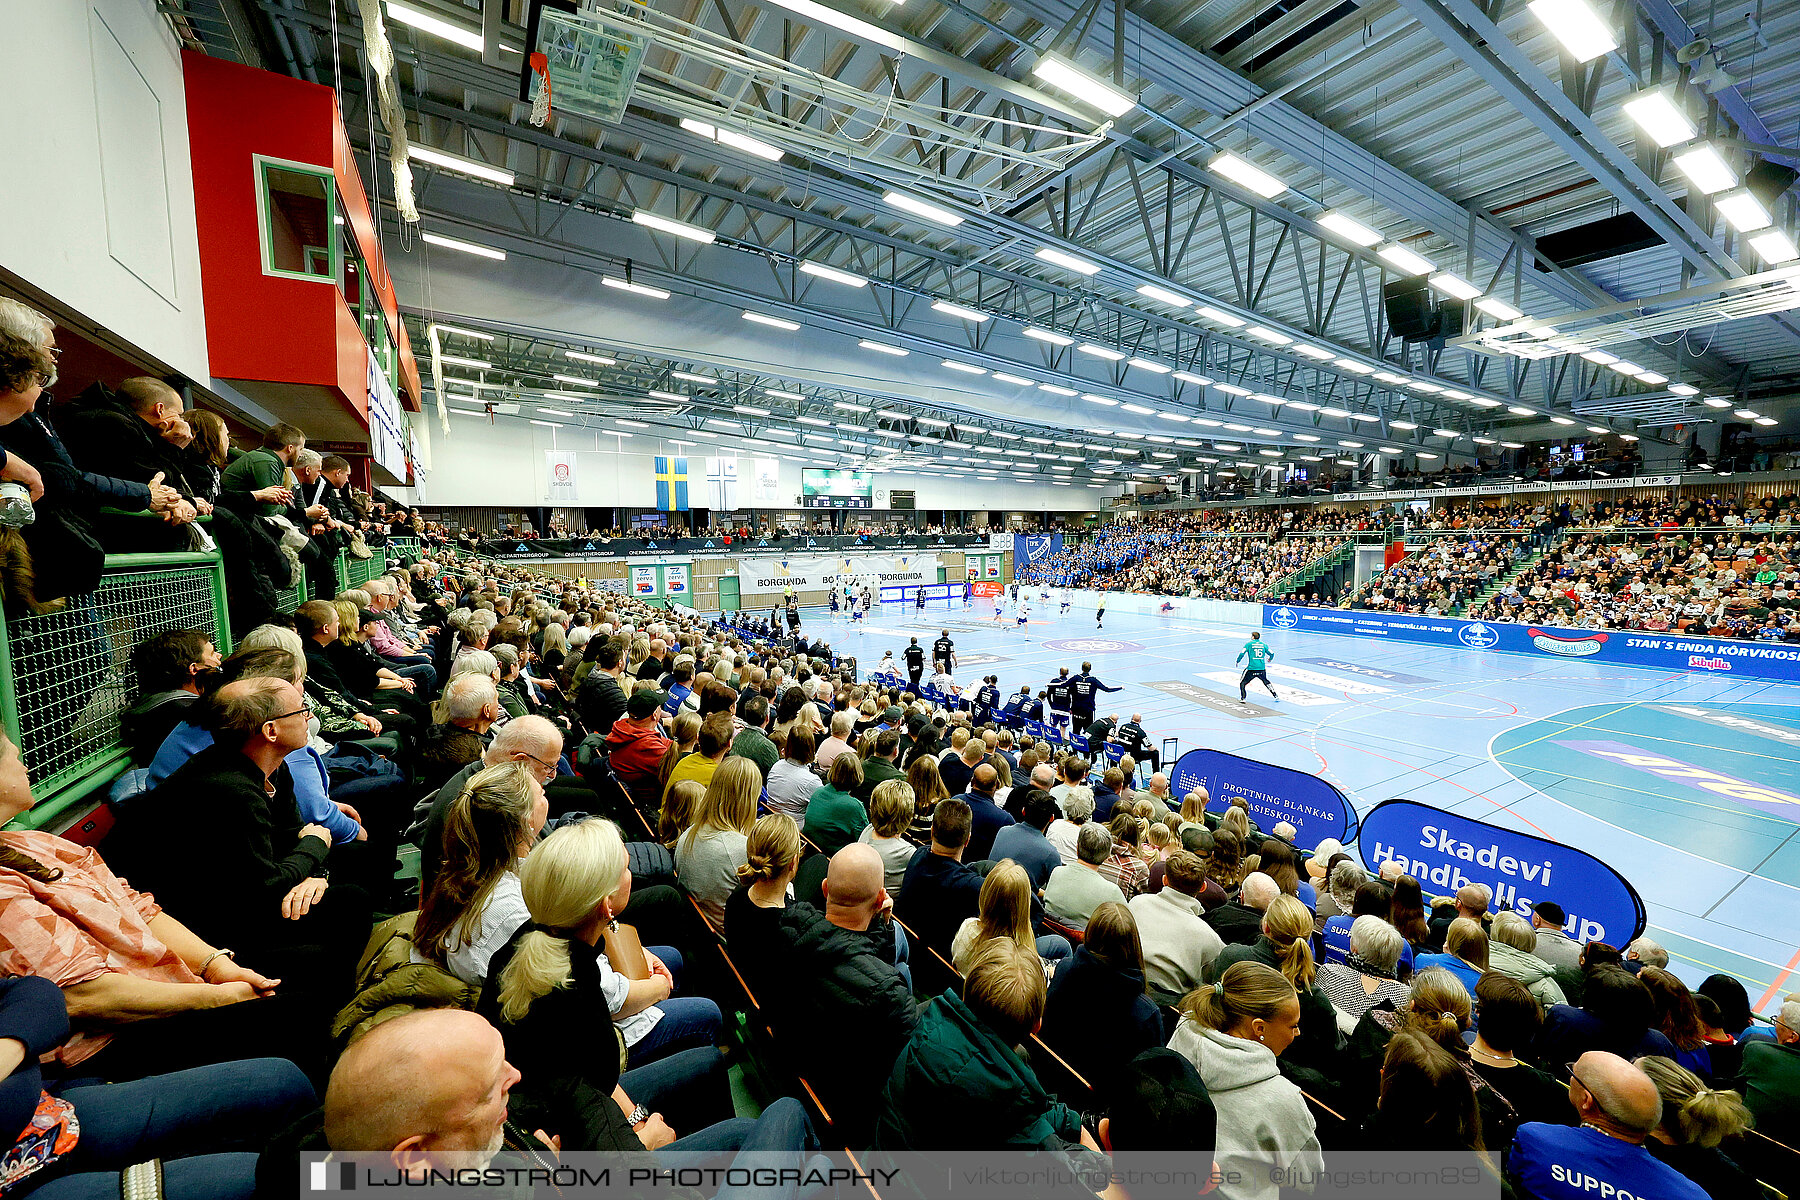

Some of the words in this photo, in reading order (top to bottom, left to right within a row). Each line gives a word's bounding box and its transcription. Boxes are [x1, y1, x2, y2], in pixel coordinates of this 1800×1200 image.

[1641, 477, 1659, 485] VIP
[992, 534, 1012, 549] SBB
[757, 577, 807, 587] BORGUNDA
[881, 572, 923, 581] BORGUNDA
[1253, 648, 1264, 658] 16
[1675, 642, 1715, 654] ENDA
[1690, 656, 1731, 670] Sibylla
[1222, 782, 1281, 805] DROTTNING
[1283, 799, 1335, 821] BLANKAS
[1220, 794, 1304, 827] GYASIESKOLA
[1419, 825, 1552, 887] Skadevi
